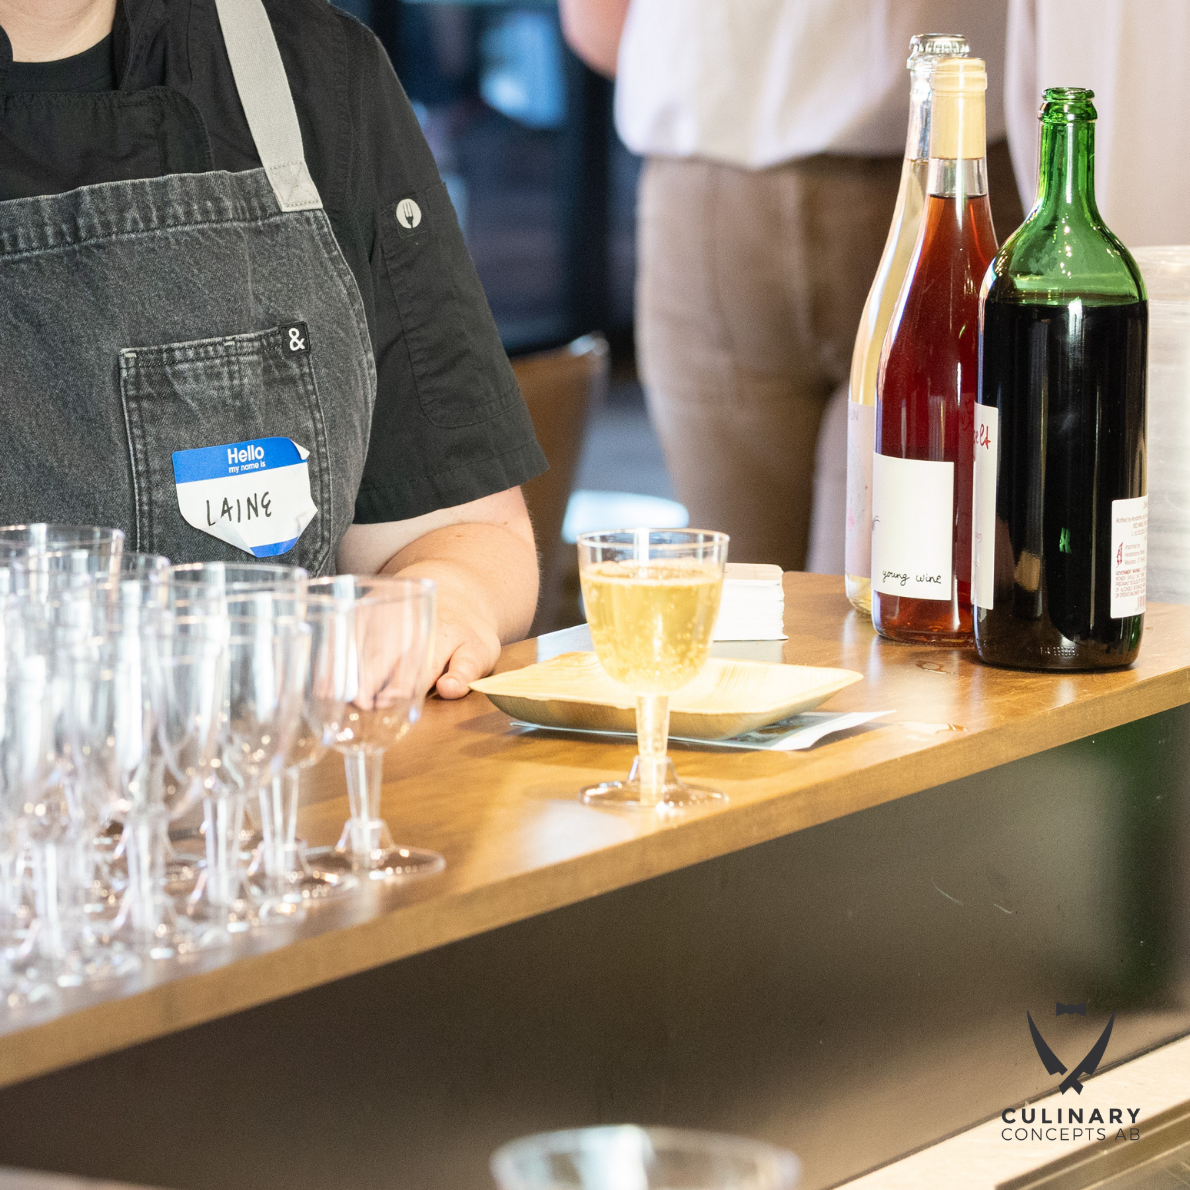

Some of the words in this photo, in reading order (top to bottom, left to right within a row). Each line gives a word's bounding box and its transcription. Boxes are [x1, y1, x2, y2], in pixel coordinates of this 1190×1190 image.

[288, 327, 305, 350] &
[227, 444, 265, 465] Hello
[228, 465, 240, 474] my
[240, 462, 260, 472] name
[260, 460, 266, 468] is
[206, 491, 272, 527] LAINE
[882, 570, 911, 587] young
[915, 573, 942, 585] wine
